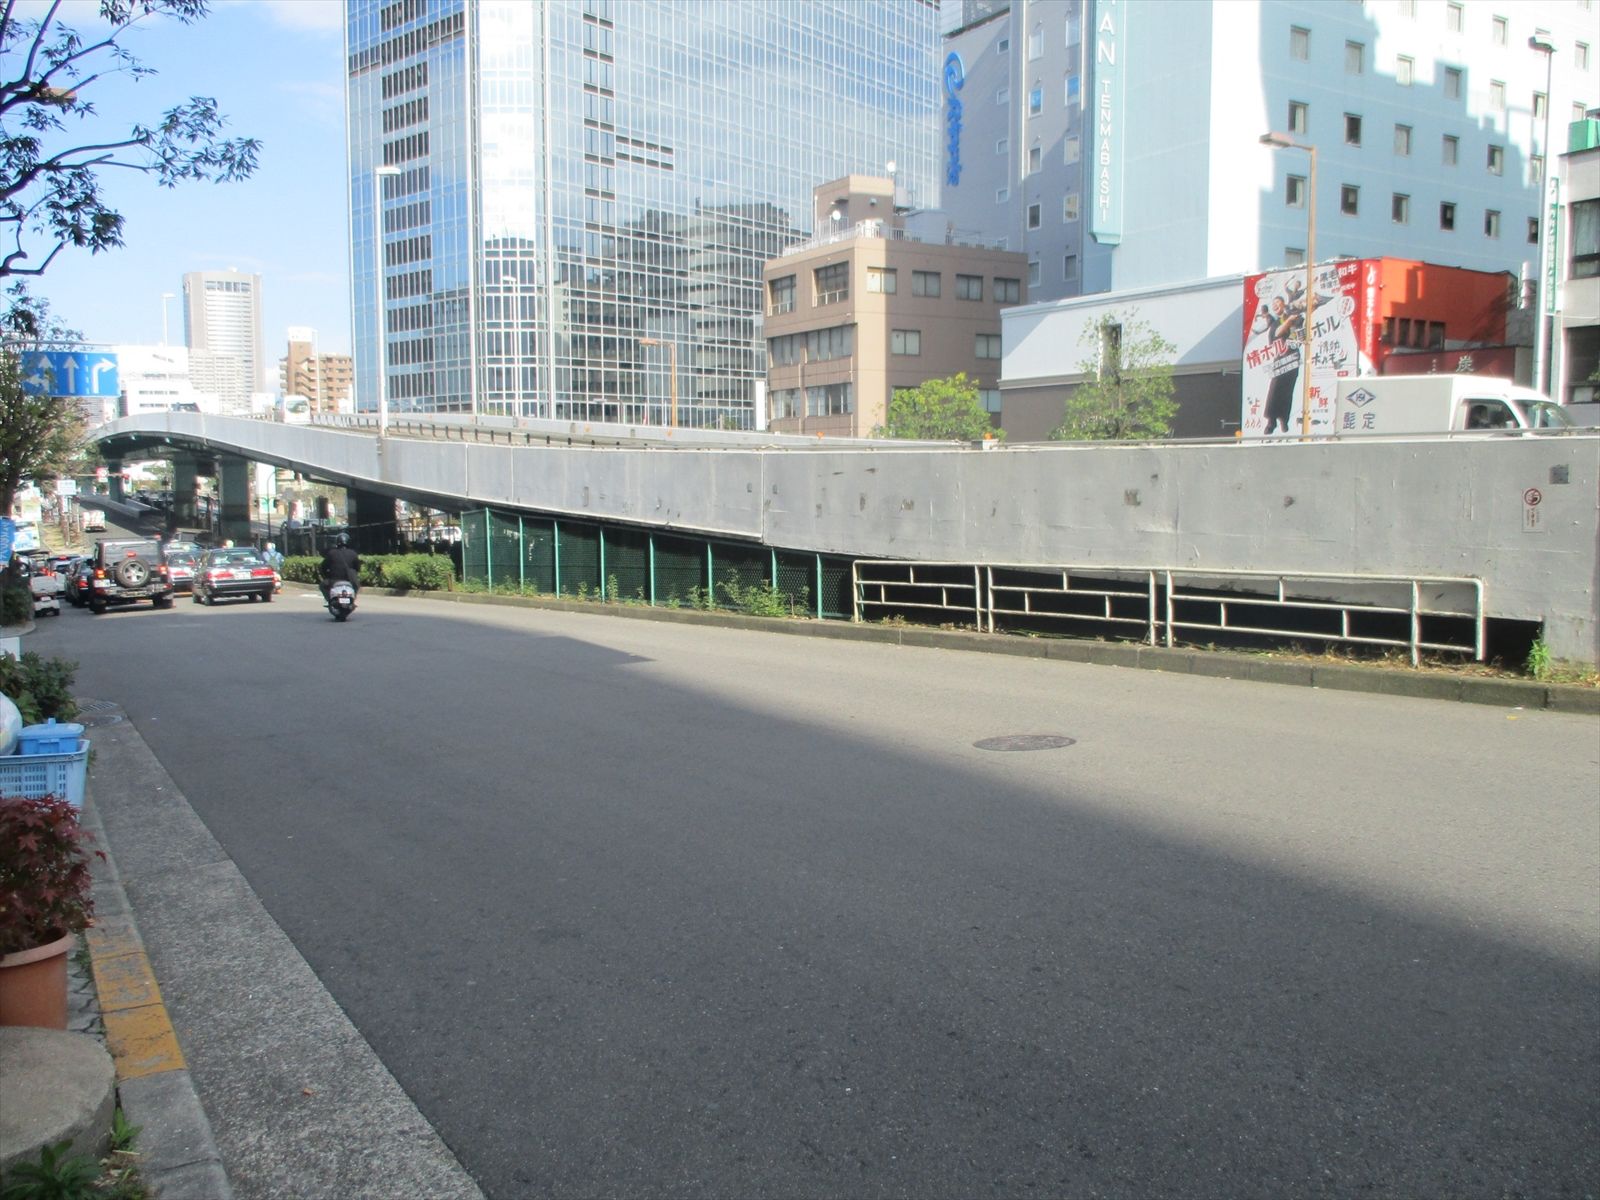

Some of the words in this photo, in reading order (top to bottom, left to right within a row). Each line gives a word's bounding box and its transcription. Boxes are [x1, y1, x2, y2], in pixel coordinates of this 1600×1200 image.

[1098, 0, 1116, 67] AN
[1099, 79, 1112, 224] TENMABASHI
[1246, 340, 1288, 369] 情ホル
[1455, 354, 1474, 373] 炭
